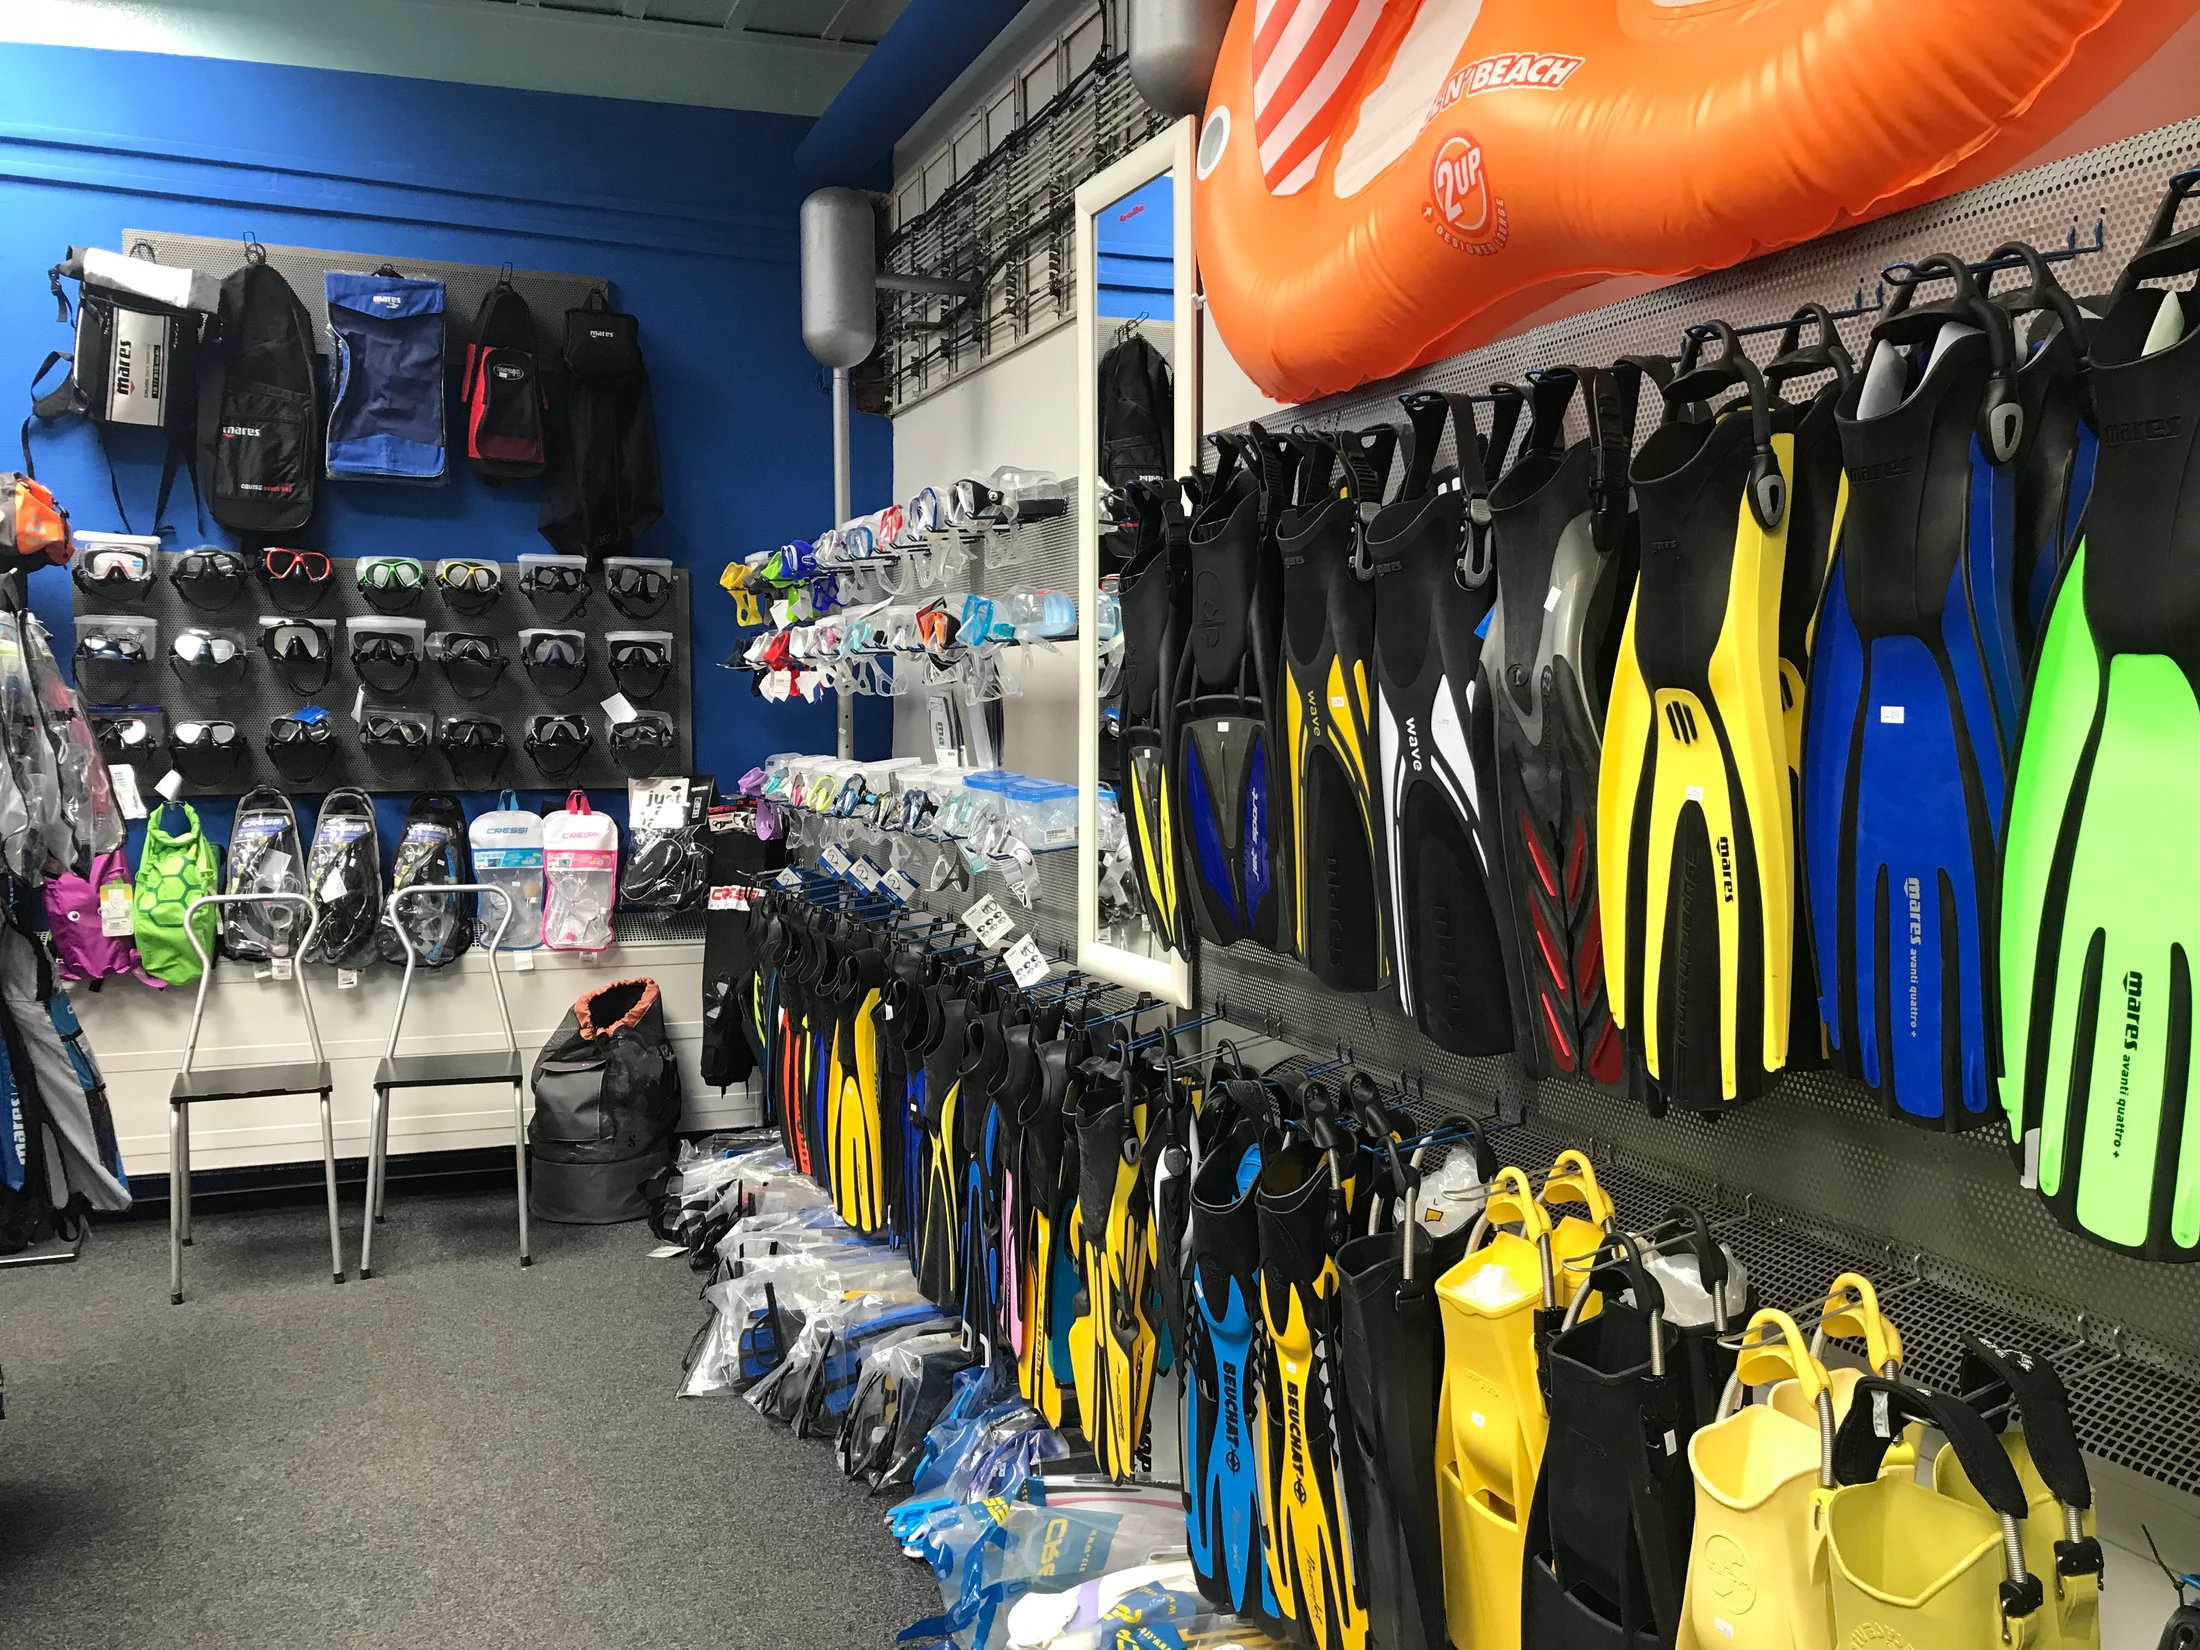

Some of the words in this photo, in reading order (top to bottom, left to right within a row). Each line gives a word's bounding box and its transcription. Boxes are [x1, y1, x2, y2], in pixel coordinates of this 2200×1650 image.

[1470, 56, 1579, 92] BEACH
[1437, 147, 1480, 222] 2UP
[1436, 224, 1497, 255] DESIGNER
[1494, 198, 1508, 247] LOUNGE
[590, 330, 614, 338] mares
[117, 340, 132, 395] mares
[222, 426, 260, 437] mares
[2104, 415, 2184, 448] mares
[241, 483, 263, 491] CRUISE
[1307, 690, 1321, 737] wave
[1405, 717, 1423, 772] wave
[242, 818, 283, 828] CRESSI
[322, 822, 364, 832] CRESSI
[487, 827, 528, 835] CRESSI
[1719, 837, 1734, 902] mares
[1908, 877, 1922, 945] mares
[1910, 948, 1919, 984] avanti
[1909, 985, 1919, 1028] quattro
[2124, 970, 2143, 1051] mares
[2119, 1054, 2131, 1096] avanti
[11, 1098, 26, 1165] mares
[2113, 1098, 2126, 1147] quattro
[1223, 1360, 1239, 1448] BEUCHAT
[1287, 1380, 1304, 1477] BEUCHAT
